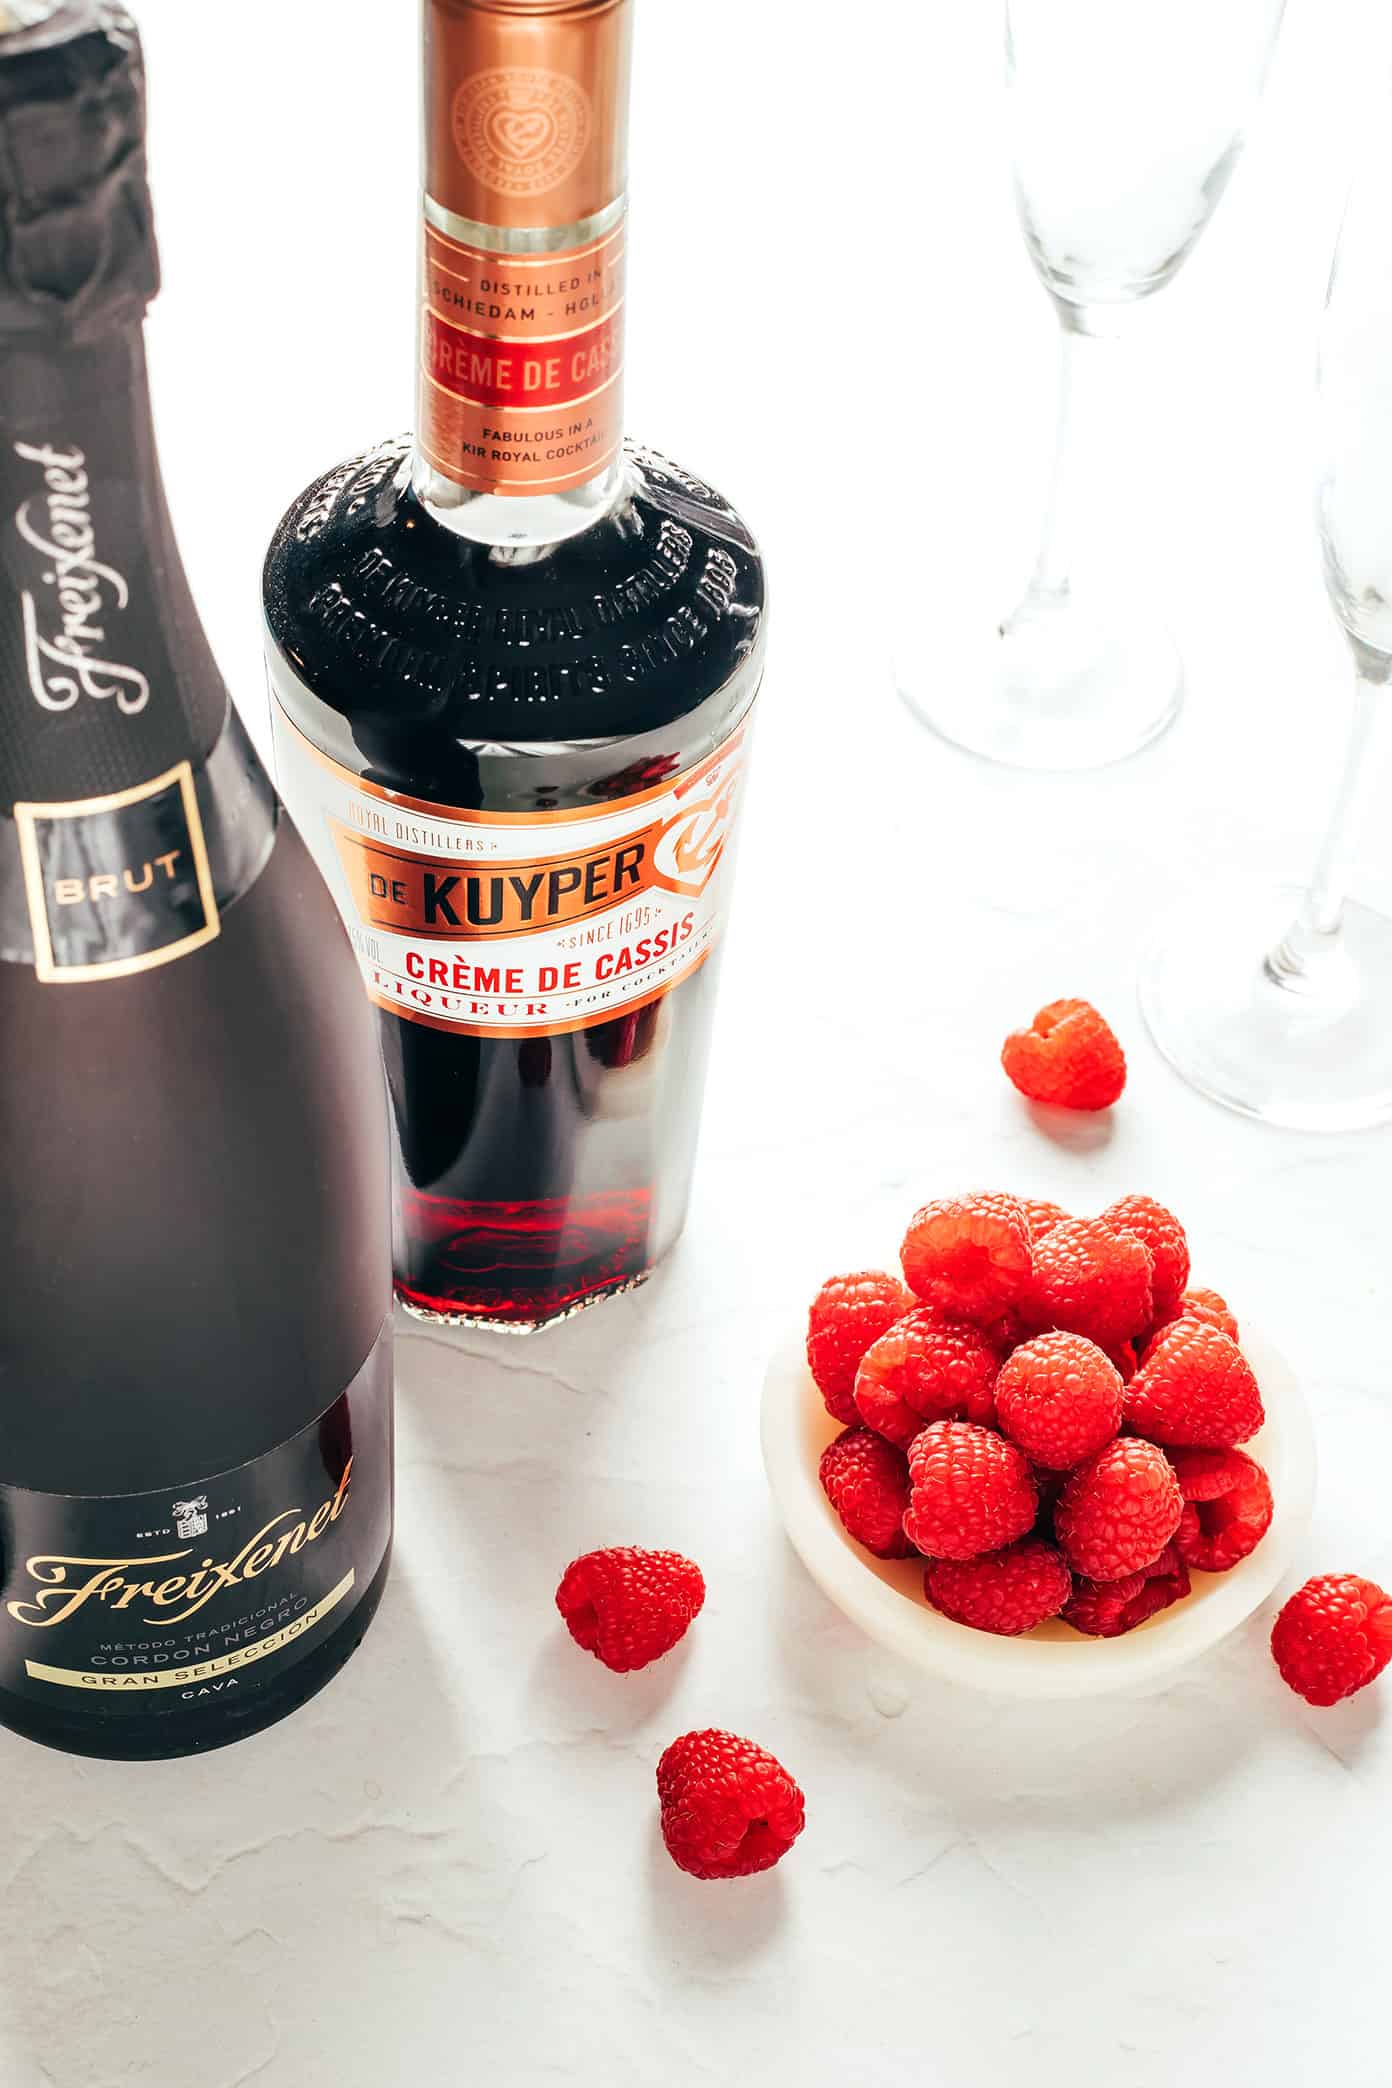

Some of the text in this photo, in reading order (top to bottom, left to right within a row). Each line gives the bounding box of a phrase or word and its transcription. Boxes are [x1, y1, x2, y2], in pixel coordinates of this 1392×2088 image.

[480, 269, 601, 297] DISTILLED IN
[523, 358, 561, 391] DE
[462, 442, 487, 457] KIR
[491, 451, 541, 463] ROYAL
[482, 418, 593, 442] FABULOUS IN A
[13, 441, 150, 715] Freixenet
[396, 822, 484, 852] DISTILLERS
[54, 850, 181, 906] BRUT
[370, 843, 645, 927] DE KUYPER
[568, 906, 652, 950] SINCE 1695
[405, 911, 694, 994] CRÈME DE CASSIS
[373, 971, 547, 1017] LIQUEUR
[573, 990, 611, 1007] FOR
[7, 1455, 354, 1627] Freixenet
[90, 1595, 309, 1666] CORDON NEGRO
[183, 1591, 299, 1643] TRADICIONAL
[80, 1674, 160, 1686] GRAN
[181, 1677, 240, 1700] CAVA
